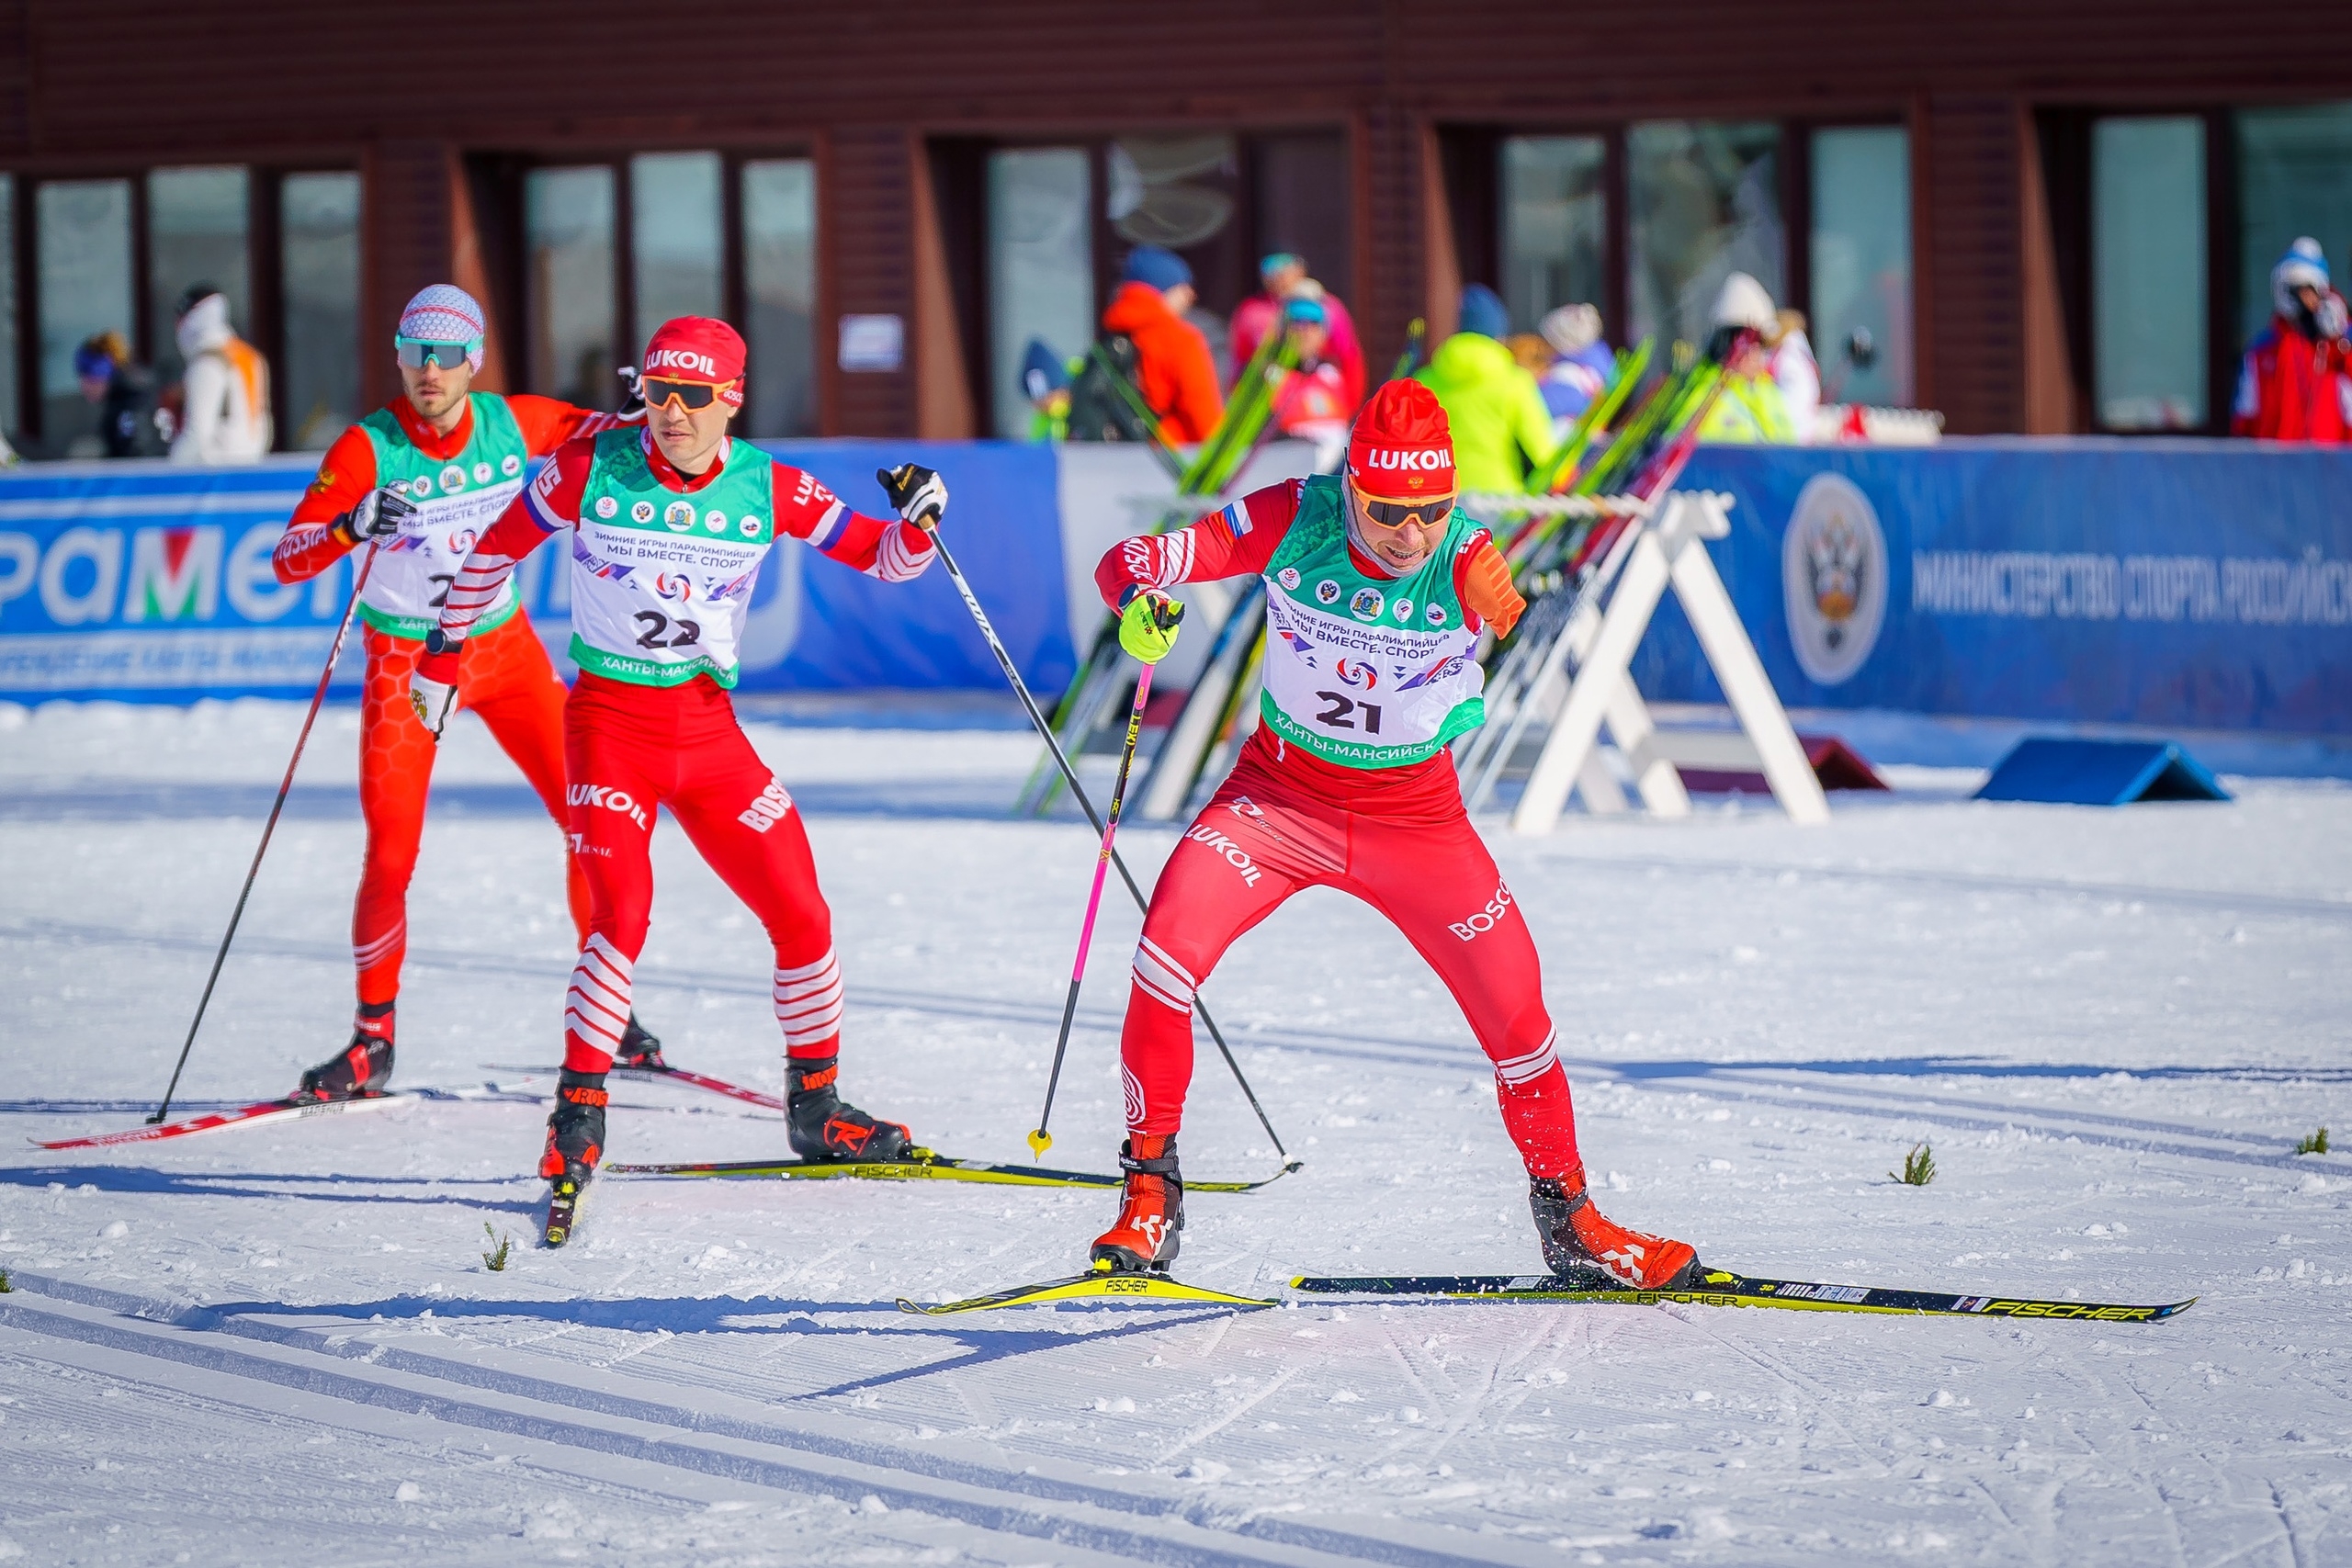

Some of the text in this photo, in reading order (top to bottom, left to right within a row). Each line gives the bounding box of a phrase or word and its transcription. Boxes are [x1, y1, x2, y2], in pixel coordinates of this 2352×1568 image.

[646, 350, 716, 377] LUKOIL
[1369, 448, 1452, 470] LUKOIL
[594, 531, 756, 558] ЗИМНИЕ ИГРЫ ПАРАЛИМПИЙЦЕВ
[606, 544, 632, 556] МЫ
[700, 557, 745, 570] СПОРТ
[2123, 554, 2218, 622] СПОРТА
[2222, 544, 2352, 626] РОССИЙС
[632, 610, 701, 649] 22
[1291, 614, 1312, 636] МЫ
[1385, 645, 1436, 660] СПОРТ
[1319, 621, 1351, 636] ИГРЫ
[1352, 629, 1451, 649] ПАРАЛИМПИЙЦЕВ
[1315, 690, 1383, 736] 21
[1274, 713, 1435, 761] ХАНТЫ-МАНСИЙСК
[1184, 824, 1262, 888] LUKOIL
[854, 1166, 933, 1178] FISCHER
[1105, 1280, 1148, 1292] FISCHER
[1637, 1292, 1739, 1307] FISCHER
[1982, 1302, 2156, 1321] FISCHER
